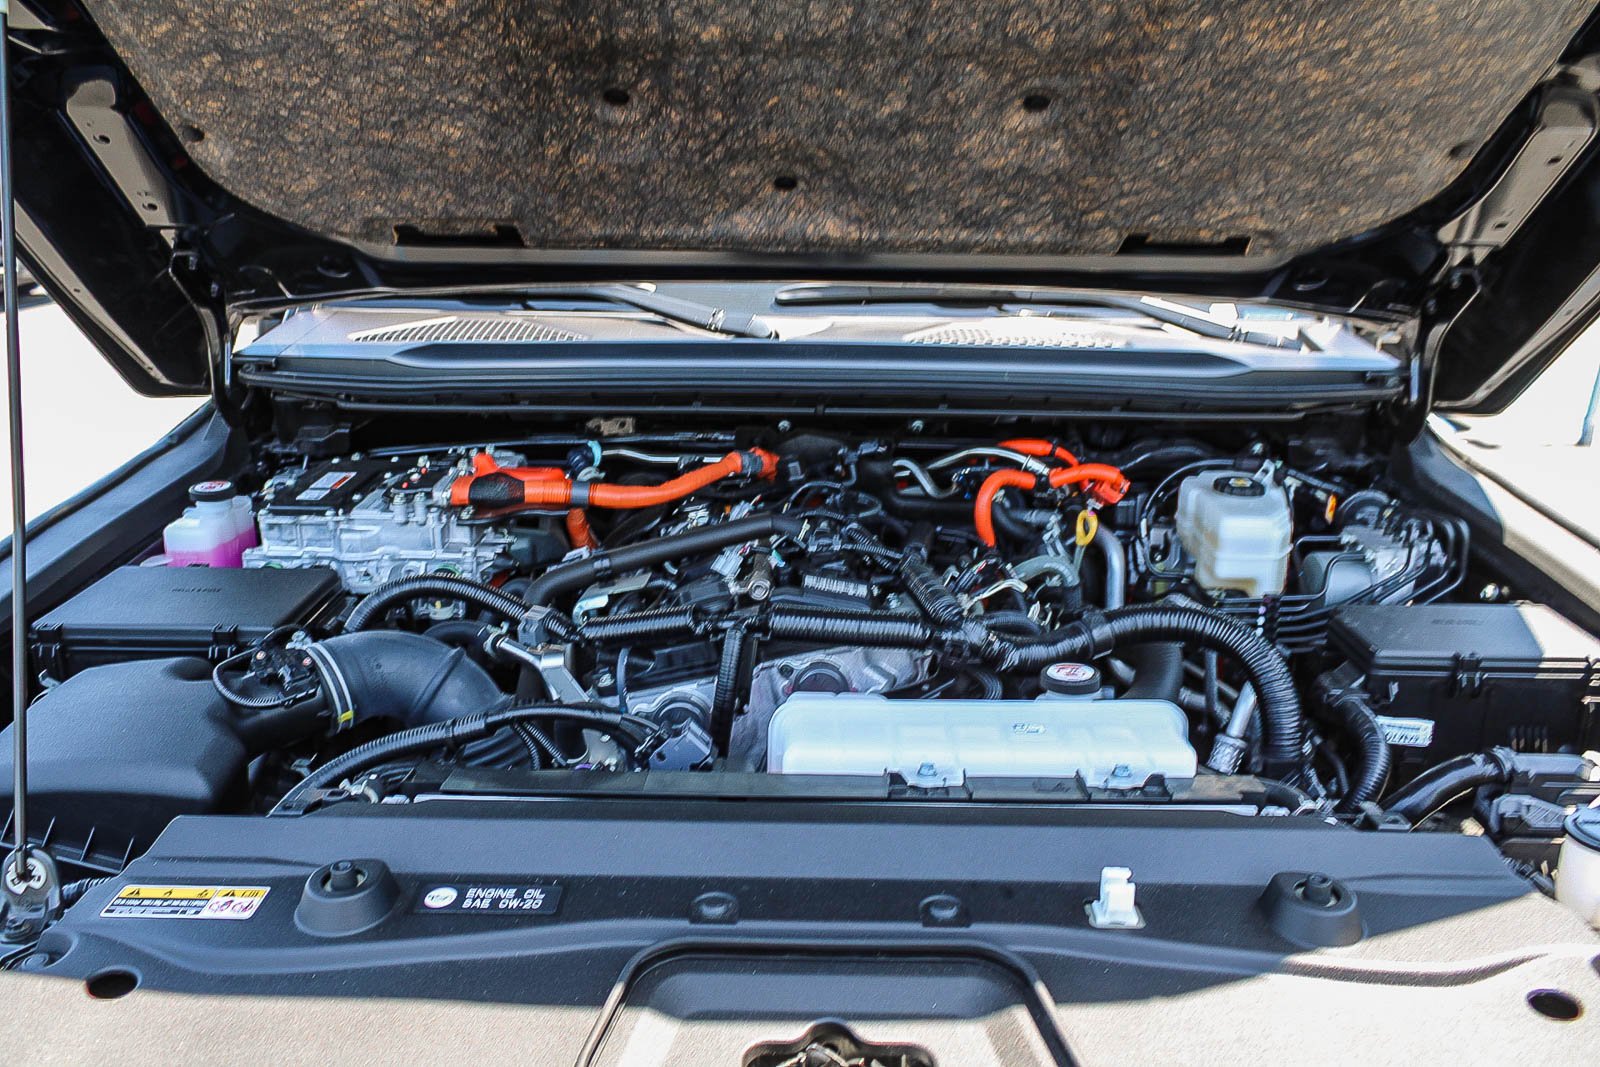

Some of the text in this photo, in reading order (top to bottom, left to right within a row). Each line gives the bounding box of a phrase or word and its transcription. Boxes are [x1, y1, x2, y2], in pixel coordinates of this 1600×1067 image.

[465, 887, 546, 900] ENGINE OIL
[461, 898, 543, 910] SAE 0W-20
